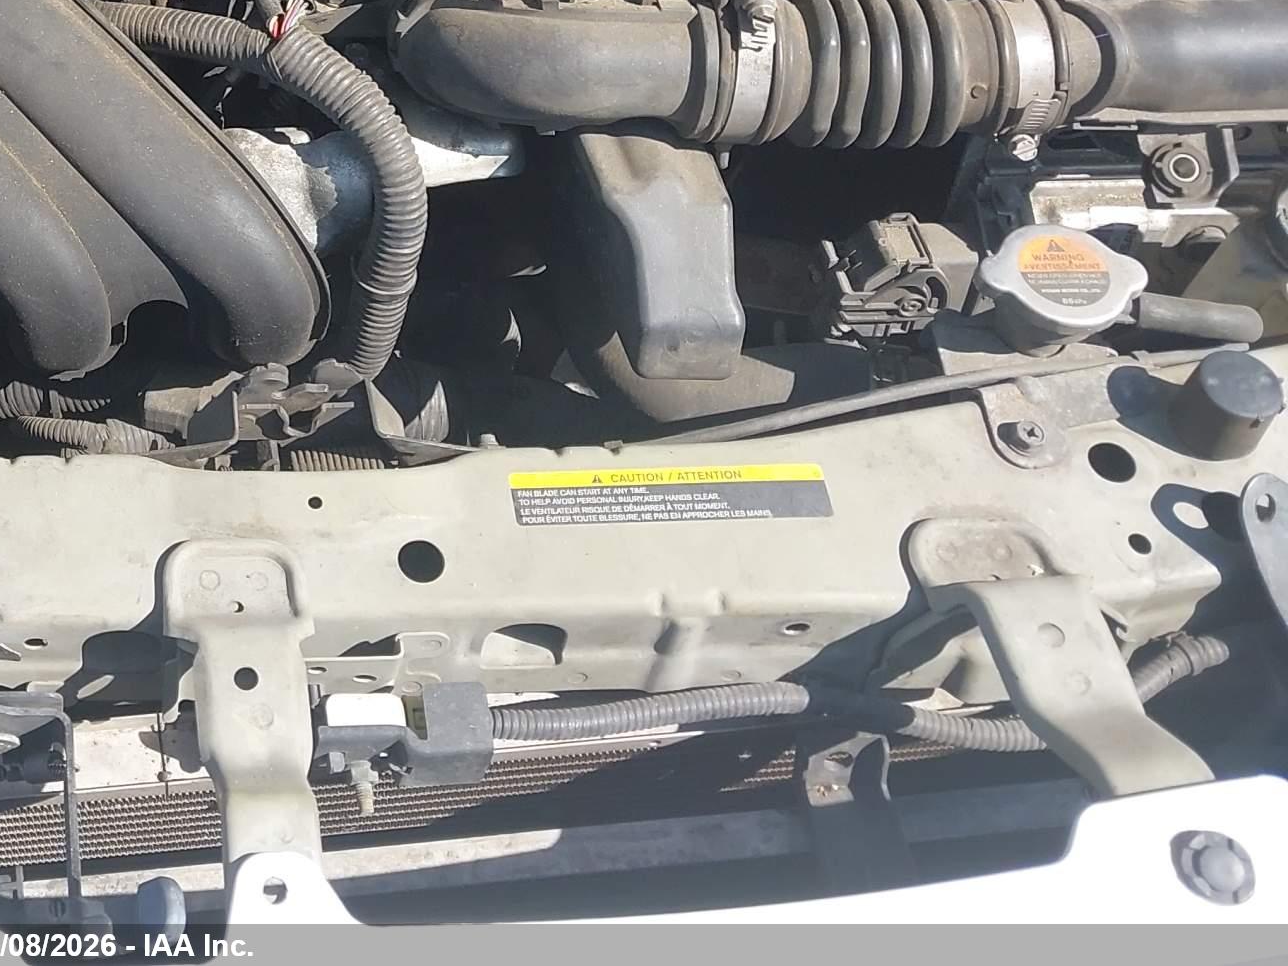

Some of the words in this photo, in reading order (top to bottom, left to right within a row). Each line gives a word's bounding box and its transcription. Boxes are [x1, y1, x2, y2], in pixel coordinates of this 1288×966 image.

[1031, 253, 1085, 262] WARNING
[610, 473, 663, 483] CAUTION
[677, 470, 742, 481] ATTENTION
[517, 490, 532, 498] FAN
[534, 489, 558, 497] BLADE
[560, 488, 577, 496] CAN
[665, 493, 692, 501] HANDS
[532, 506, 580, 515] VENTILATEUR
[582, 505, 610, 514] RISQUE
[624, 503, 665, 512] DÉMARRER
[522, 516, 545, 524] POUR
[547, 515, 572, 523] ÉVITER
[573, 514, 598, 522] TOUTE
[682, 510, 729, 518] APPROCHER
